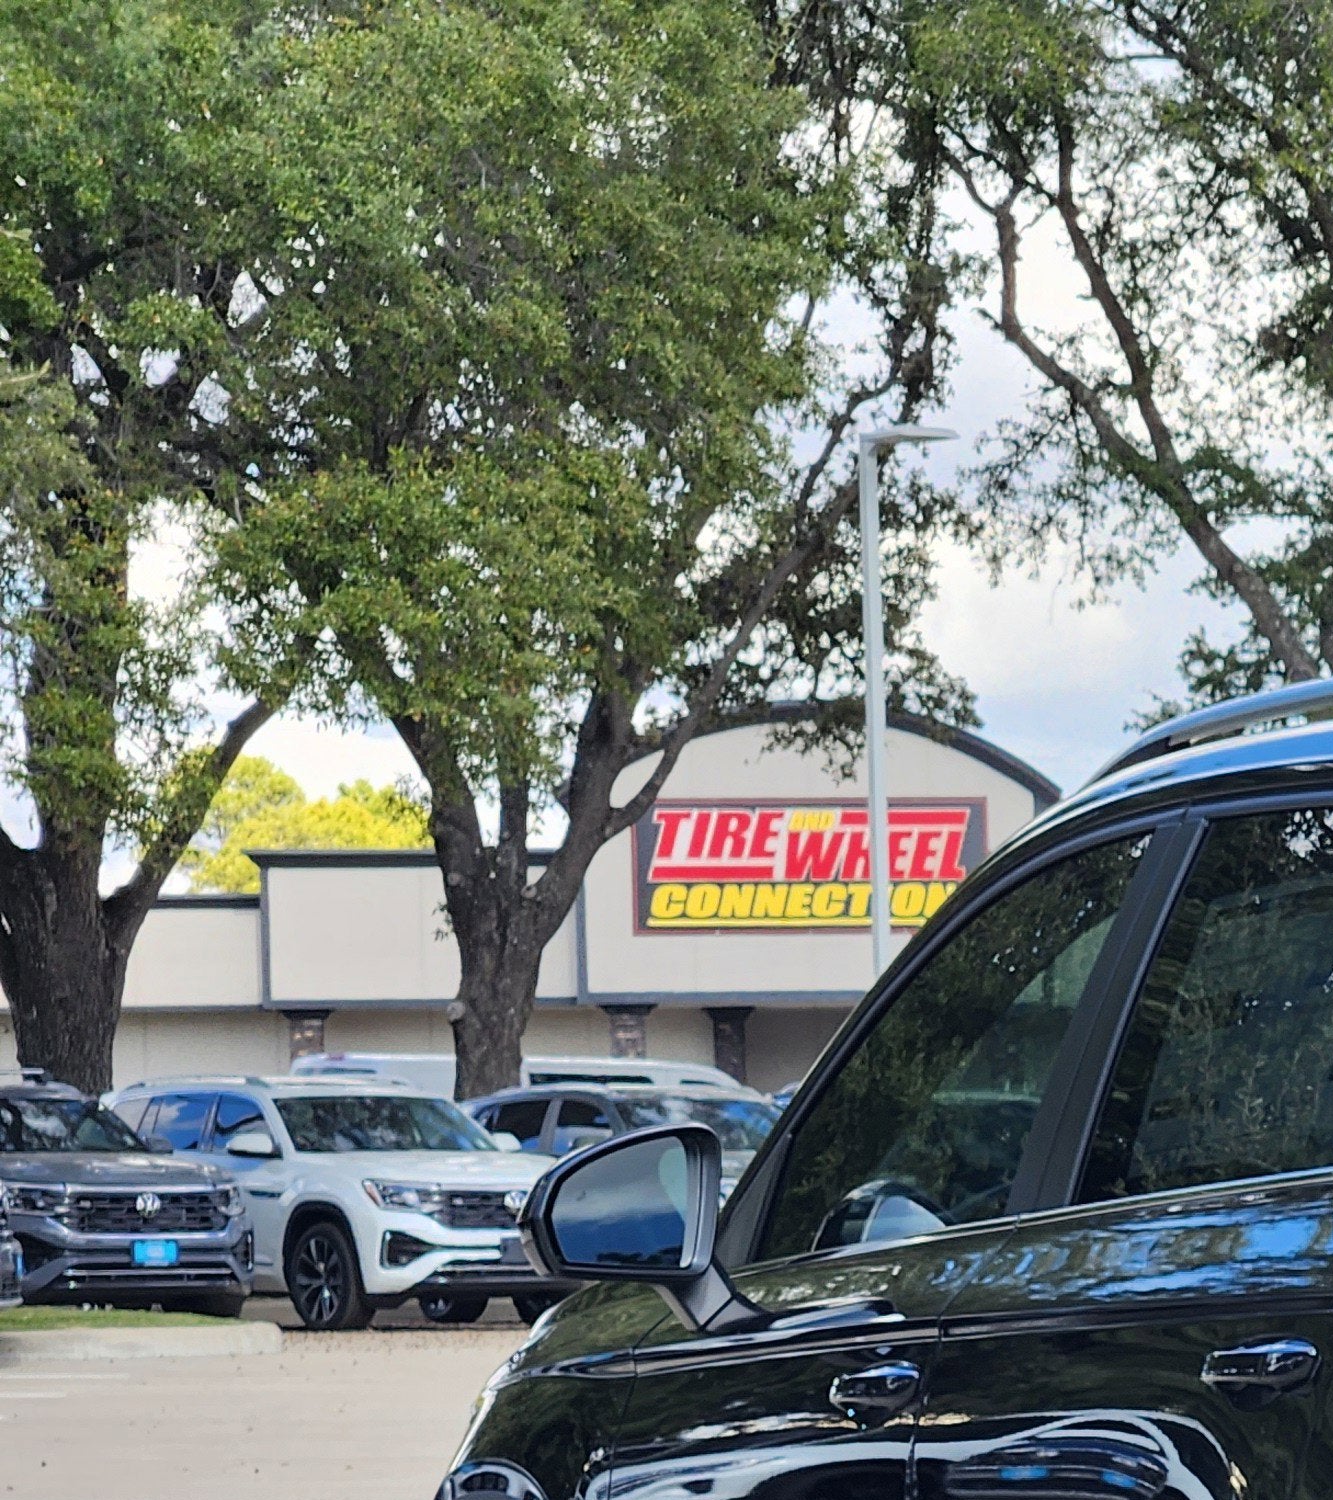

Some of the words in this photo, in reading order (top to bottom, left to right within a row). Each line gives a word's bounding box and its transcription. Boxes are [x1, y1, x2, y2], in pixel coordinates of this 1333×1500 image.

[654, 809, 785, 859] TIRE
[788, 810, 836, 832] AND
[784, 829, 968, 880] WHEEL
[650, 881, 957, 919] CONNECTON
